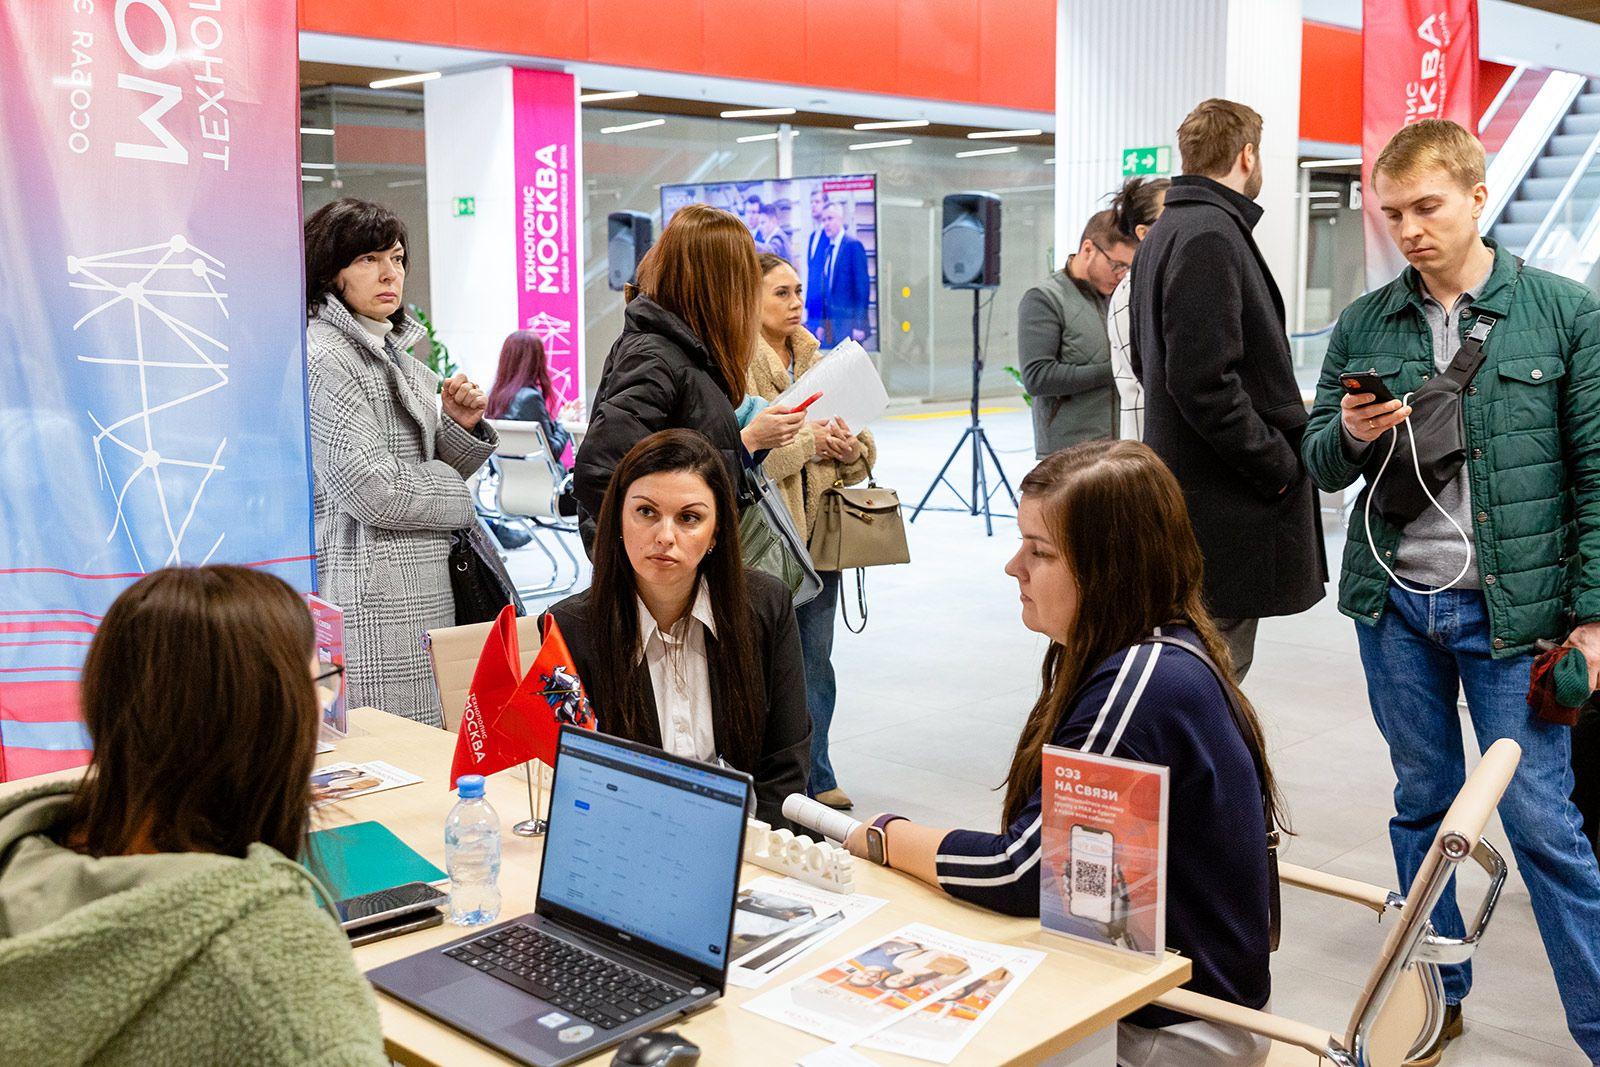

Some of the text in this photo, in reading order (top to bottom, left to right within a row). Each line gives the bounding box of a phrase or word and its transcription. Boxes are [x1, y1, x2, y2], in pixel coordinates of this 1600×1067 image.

[523, 186, 537, 293] ТЕХНОПОЛИС
[535, 143, 560, 294] МОСКВА
[1054, 779, 1119, 802] НА СВЯЗИ
[1055, 766, 1081, 780] ОЭЗ
